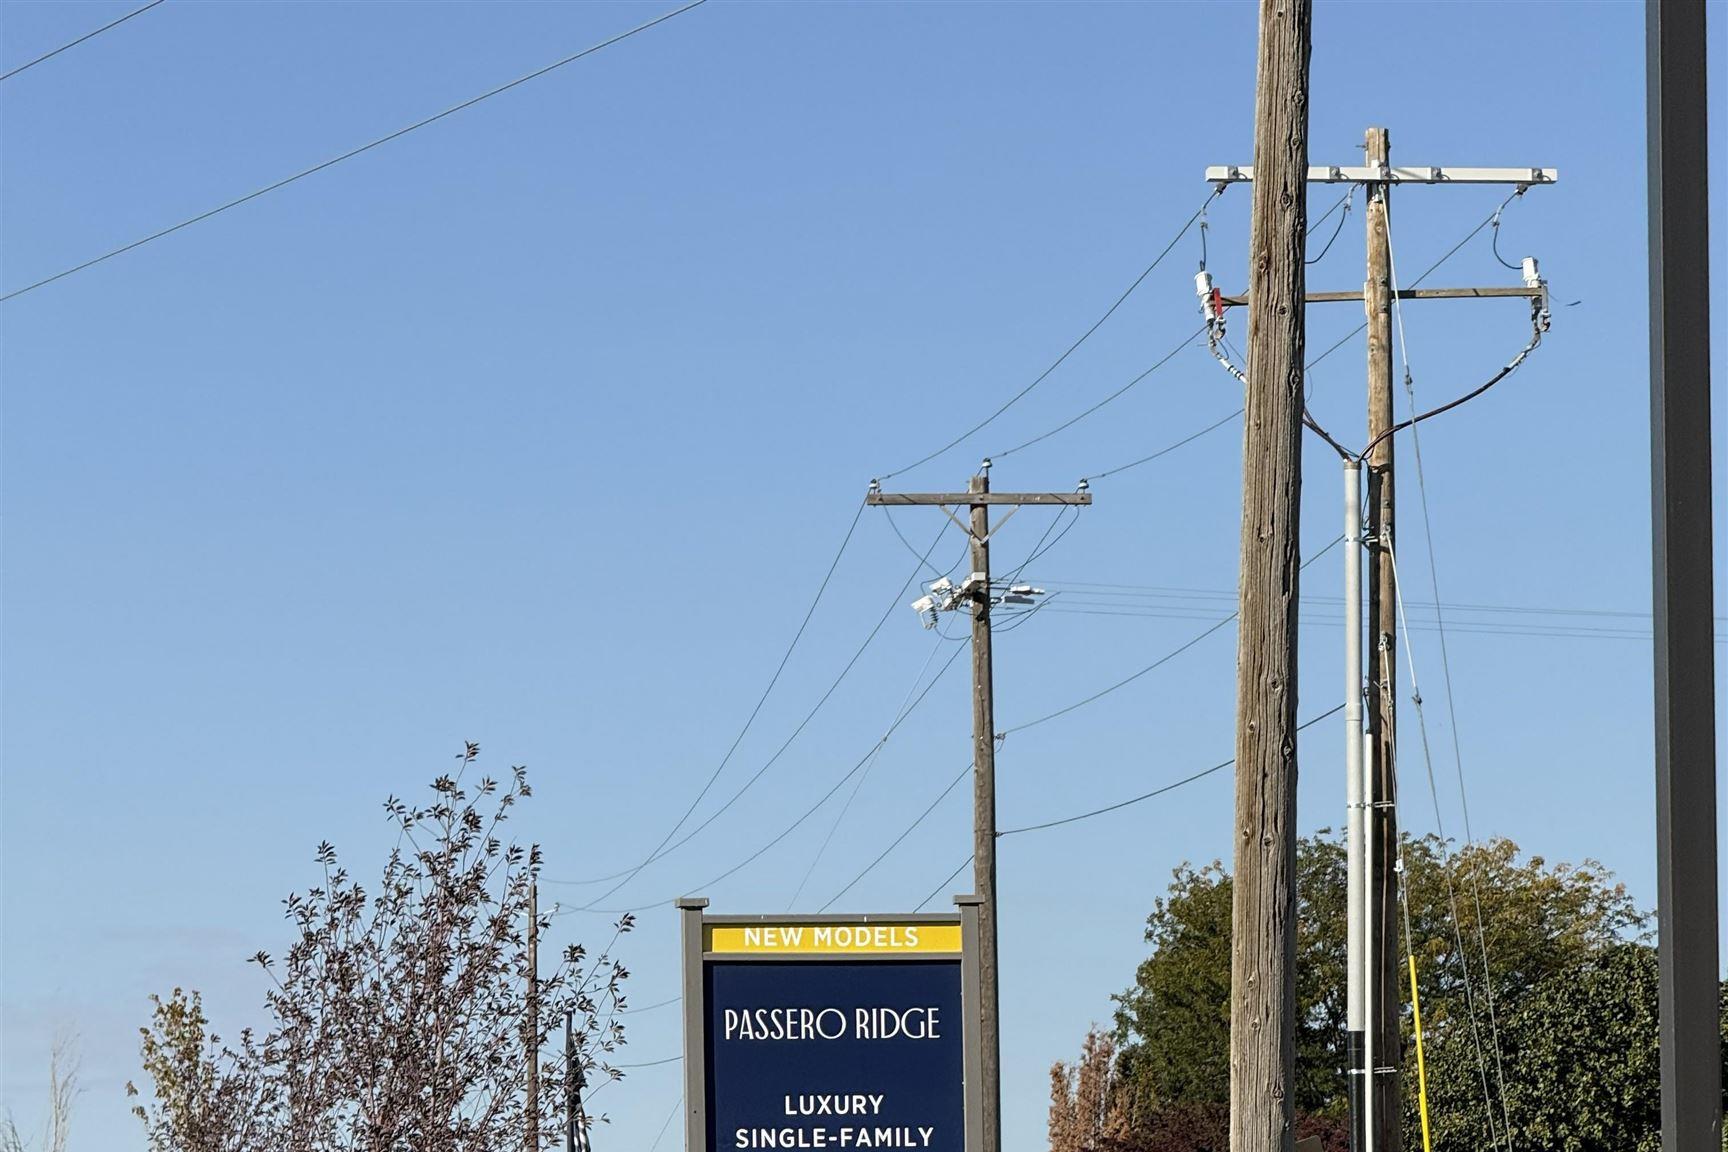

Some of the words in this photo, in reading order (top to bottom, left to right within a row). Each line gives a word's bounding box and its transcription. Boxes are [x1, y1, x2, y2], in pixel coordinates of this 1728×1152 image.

[744, 928, 803, 947] NEW
[812, 927, 919, 947] MODELS
[724, 1008, 847, 1040] PASSERO
[855, 1007, 941, 1040] RIDGE
[785, 1095, 884, 1115] LUXURY
[735, 1127, 934, 1148] SINGLE-FAMILY
